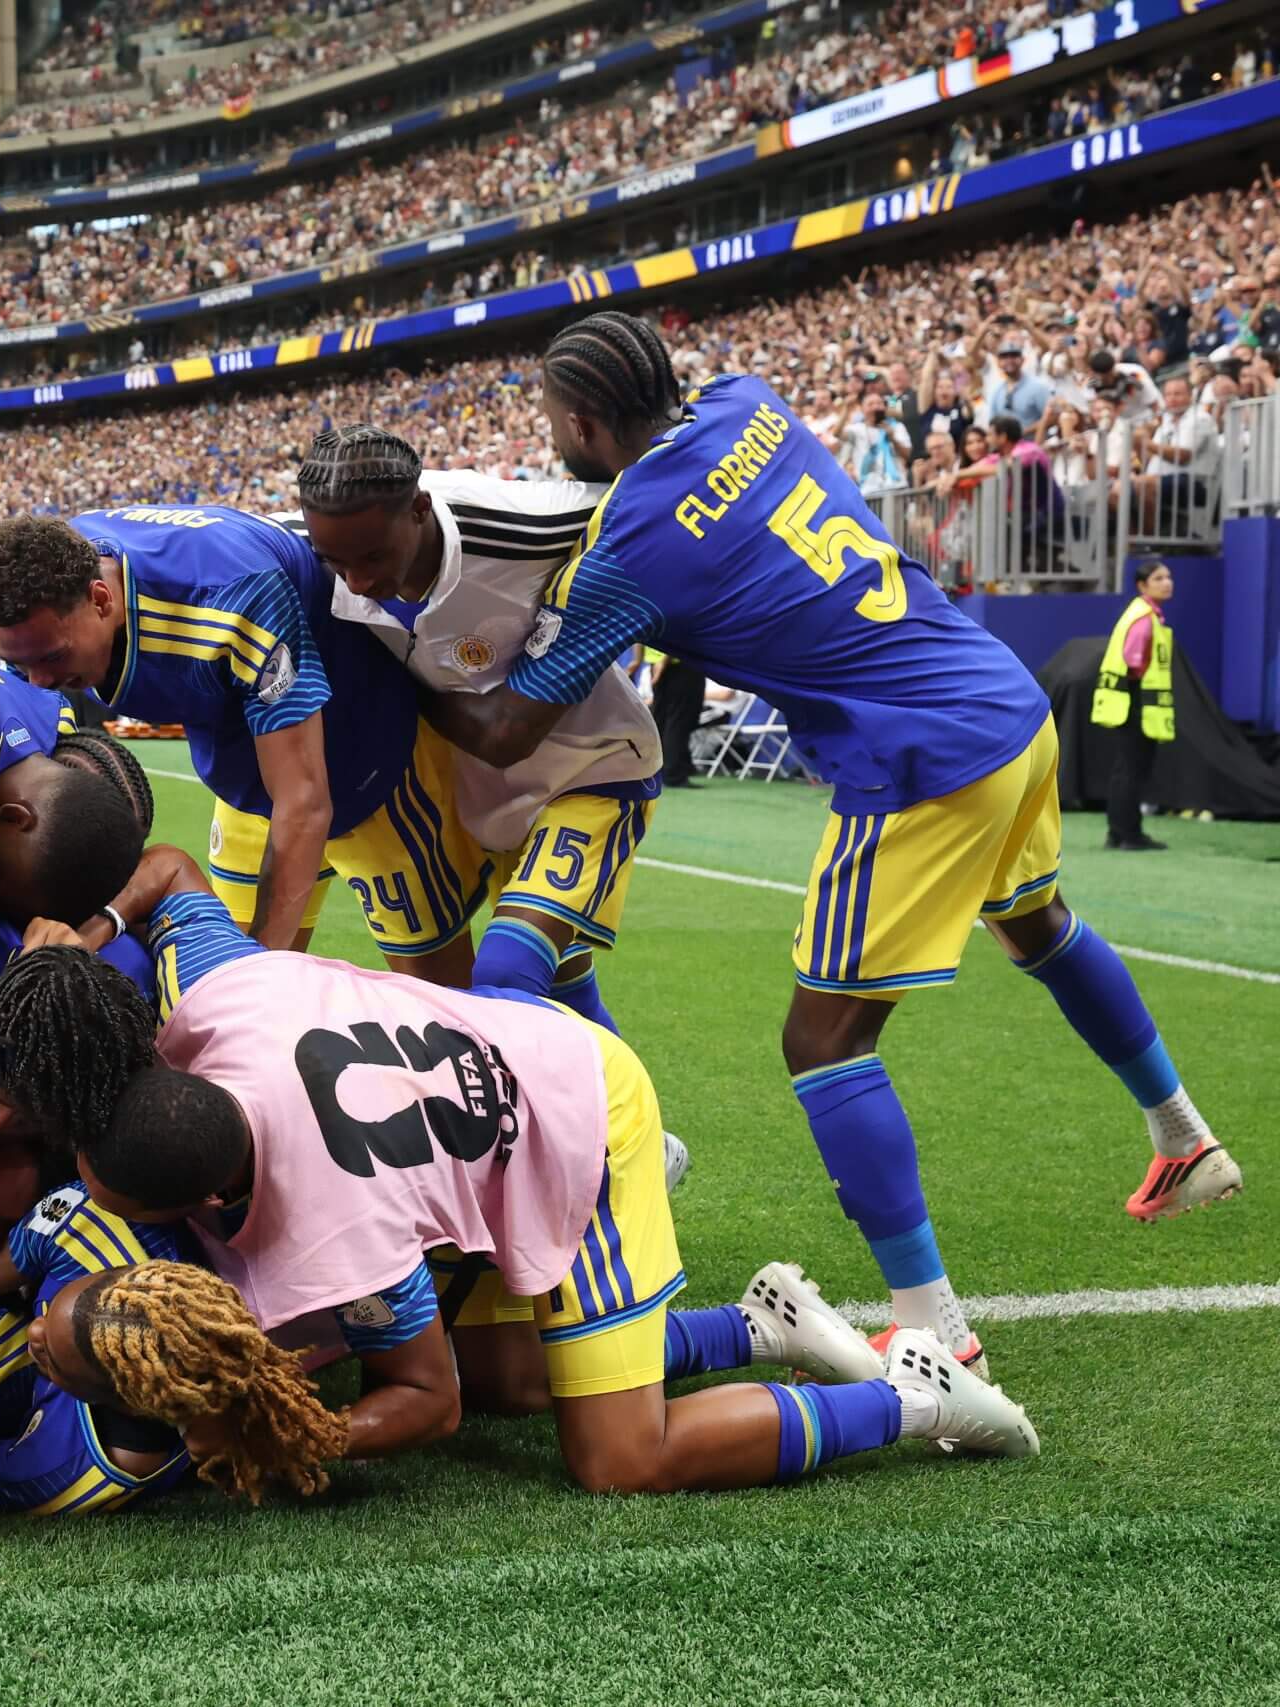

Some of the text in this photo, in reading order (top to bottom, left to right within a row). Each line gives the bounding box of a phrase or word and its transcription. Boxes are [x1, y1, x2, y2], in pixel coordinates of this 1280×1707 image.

[1070, 124, 1143, 171] GOAL
[618, 166, 697, 199] HOUSTON
[872, 183, 932, 227] GOAL
[705, 234, 756, 269] GOAL
[220, 350, 253, 373] GOAL
[675, 402, 789, 539] FLORANUS
[767, 473, 907, 622] 5
[517, 826, 591, 891] 15
[347, 872, 422, 933] 24
[458, 1051, 488, 1118] FIFA
